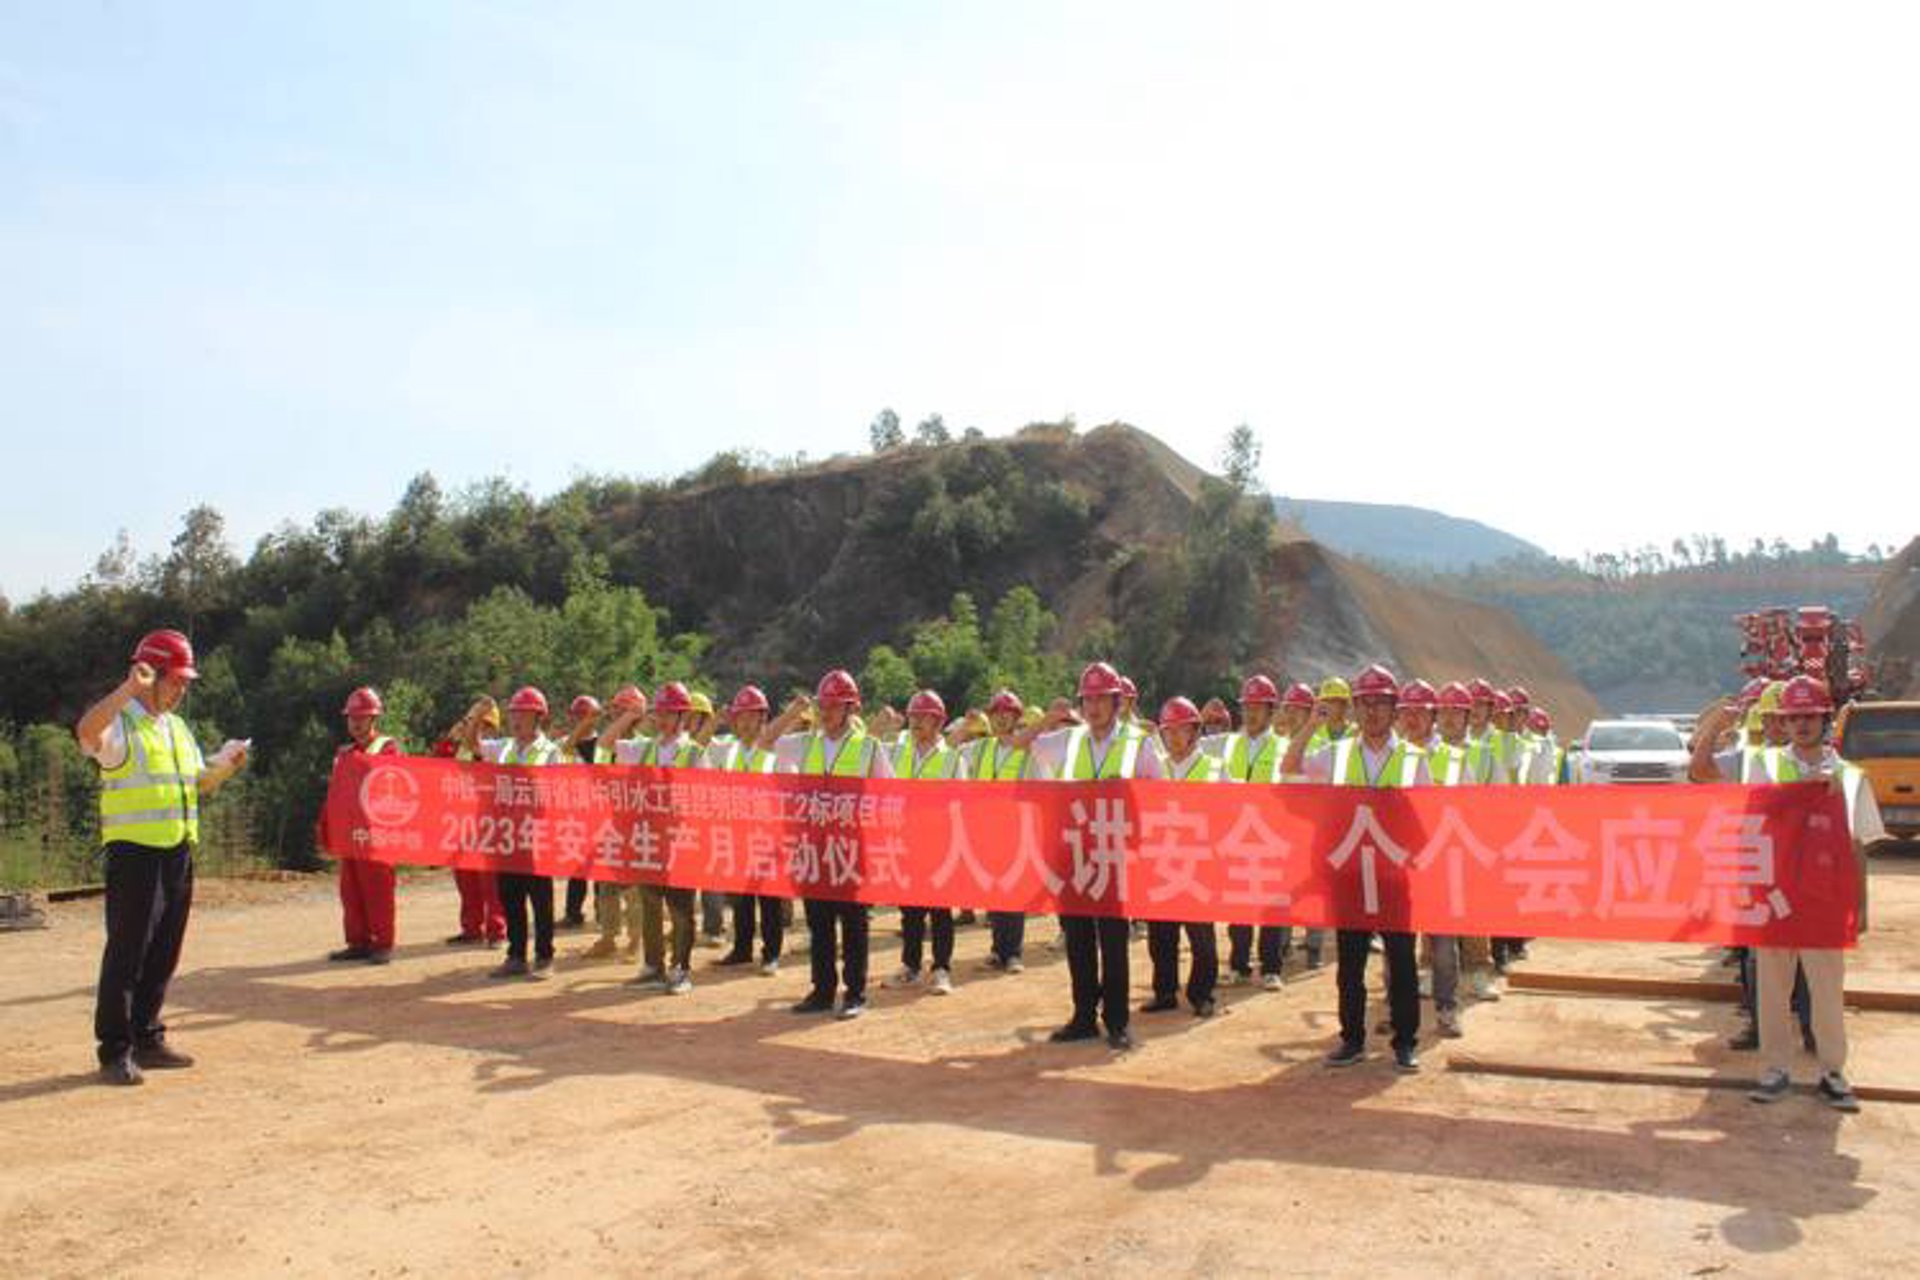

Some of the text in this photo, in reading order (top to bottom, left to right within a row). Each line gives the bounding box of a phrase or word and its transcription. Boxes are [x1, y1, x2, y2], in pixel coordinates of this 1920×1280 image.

[440, 815, 912, 888] 2023年安全生产月启动仪式
[931, 798, 1791, 928] 人人讲安全 个个会应急
